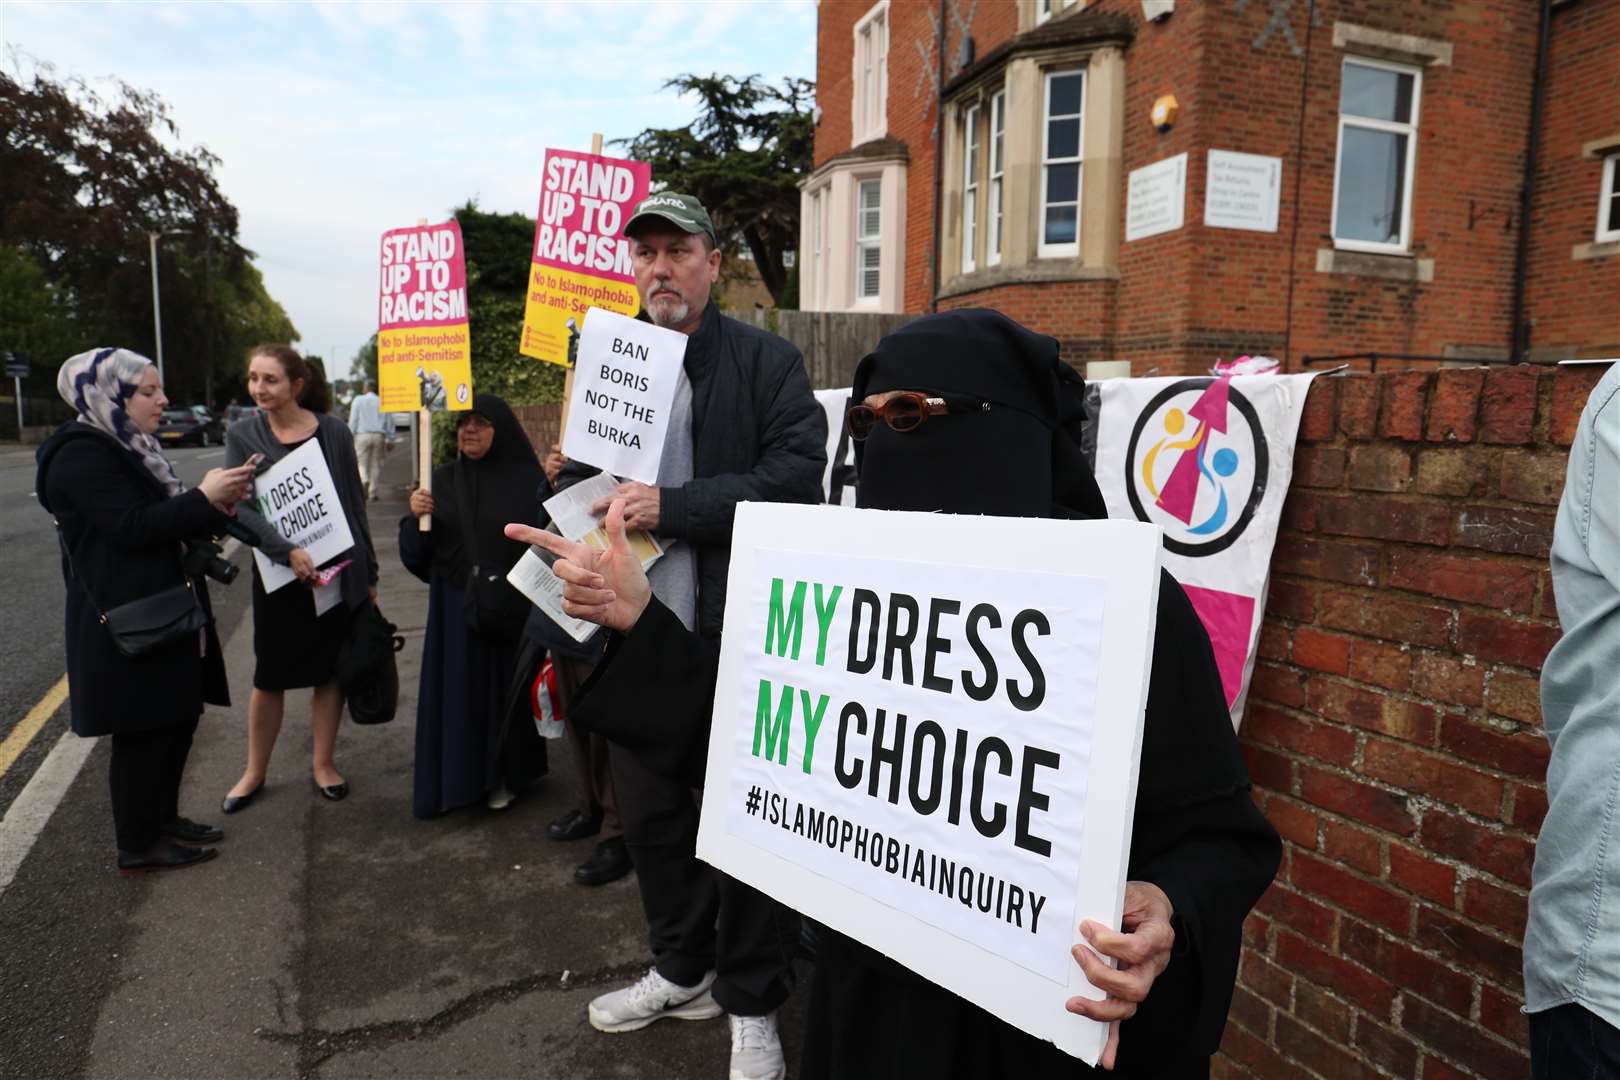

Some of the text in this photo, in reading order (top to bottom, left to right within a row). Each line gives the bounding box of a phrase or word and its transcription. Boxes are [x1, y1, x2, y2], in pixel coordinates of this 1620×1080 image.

[546, 156, 634, 203] STAND
[543, 190, 621, 236] UP TO
[382, 230, 455, 265] STAND
[537, 224, 635, 276] RACISM
[382, 260, 450, 294] UP TO
[534, 271, 634, 306] No to Islamophobia
[381, 288, 465, 324] RACISM
[531, 290, 547, 304] and
[381, 331, 465, 348] No to Islamophobia
[396, 347, 464, 363] anti-Semitism
[612, 338, 649, 361] BAN
[600, 365, 649, 392] BORIS
[585, 389, 655, 424] NOT THE
[588, 420, 641, 449] BURKA
[271, 467, 313, 510] DRESS
[280, 493, 328, 539] CHOICE
[765, 577, 1051, 711] MY DRESS
[752, 679, 1061, 858] MY CHOICE
[745, 785, 1046, 934] #ISLAMOPHOBIAINQUIRY
